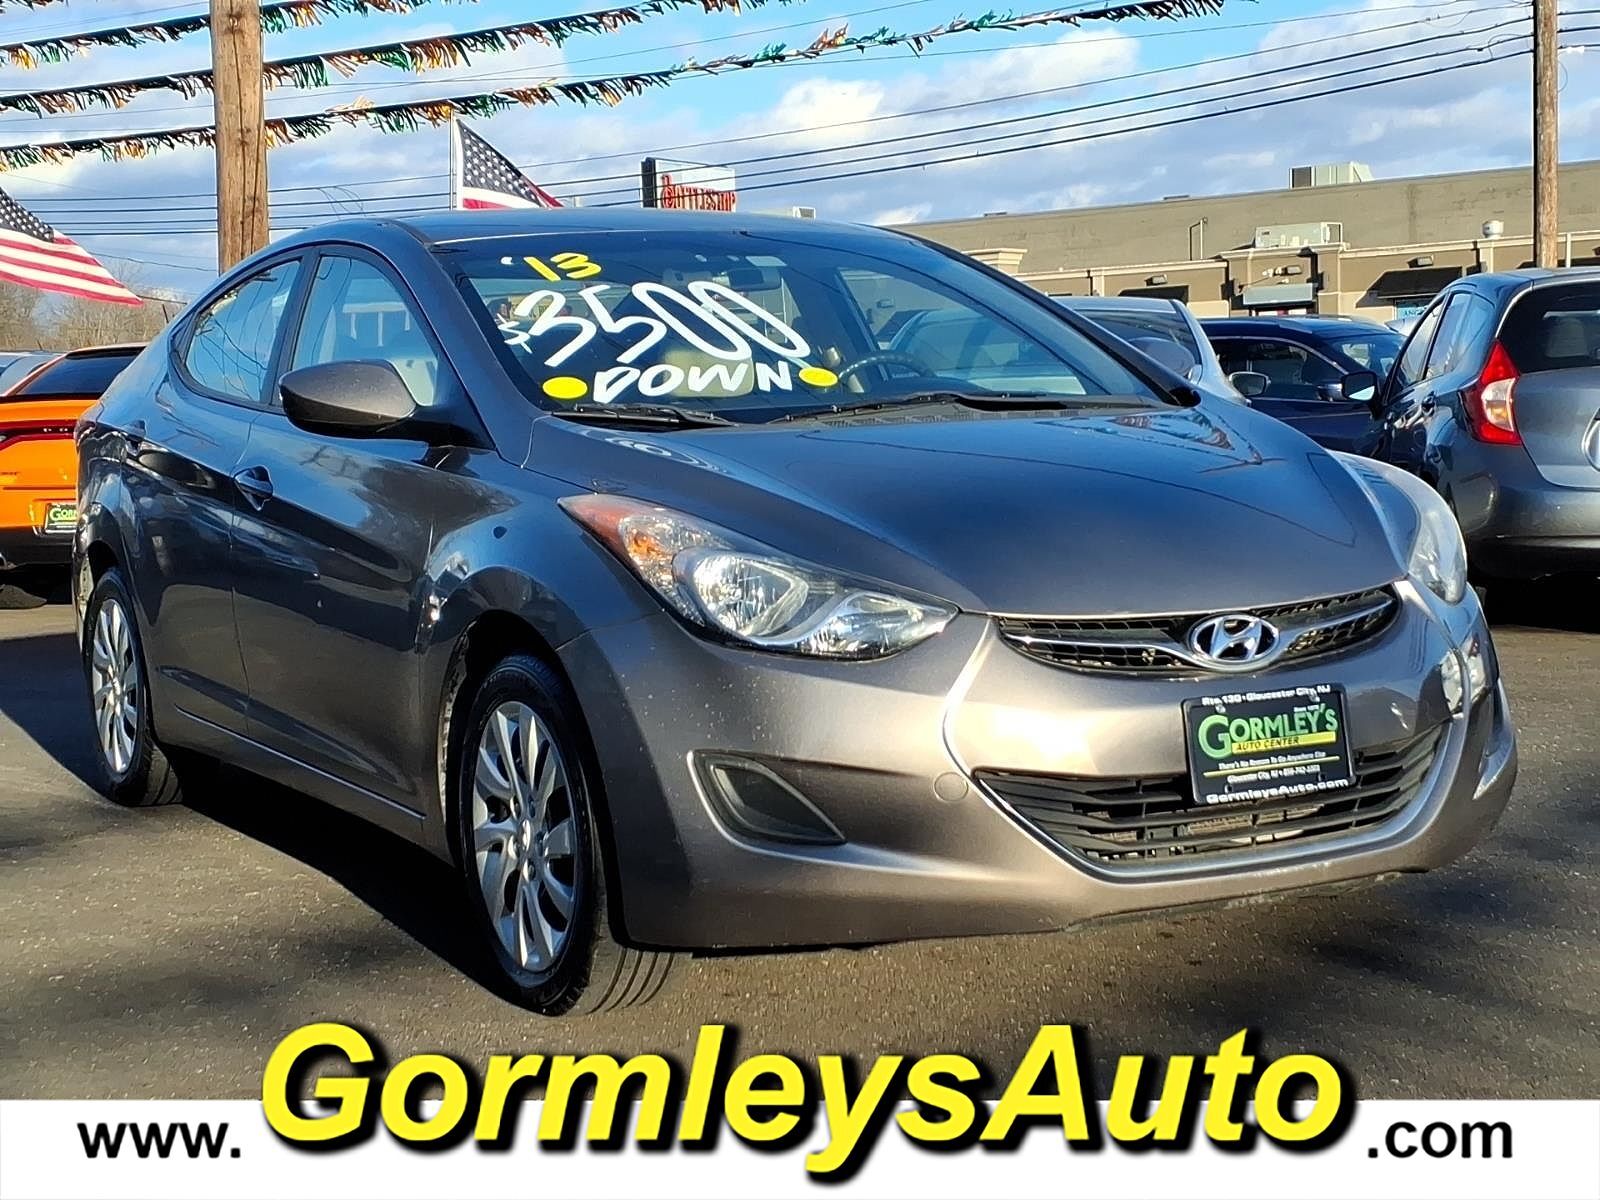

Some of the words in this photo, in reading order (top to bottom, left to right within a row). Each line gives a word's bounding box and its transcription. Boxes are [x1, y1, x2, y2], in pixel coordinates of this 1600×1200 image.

[497, 280, 812, 368] $3500
[592, 360, 794, 404] DOWN
[1198, 703, 1339, 760] GORMLEY'S
[1236, 741, 1262, 752] AUTO
[1263, 736, 1301, 749] CENTER
